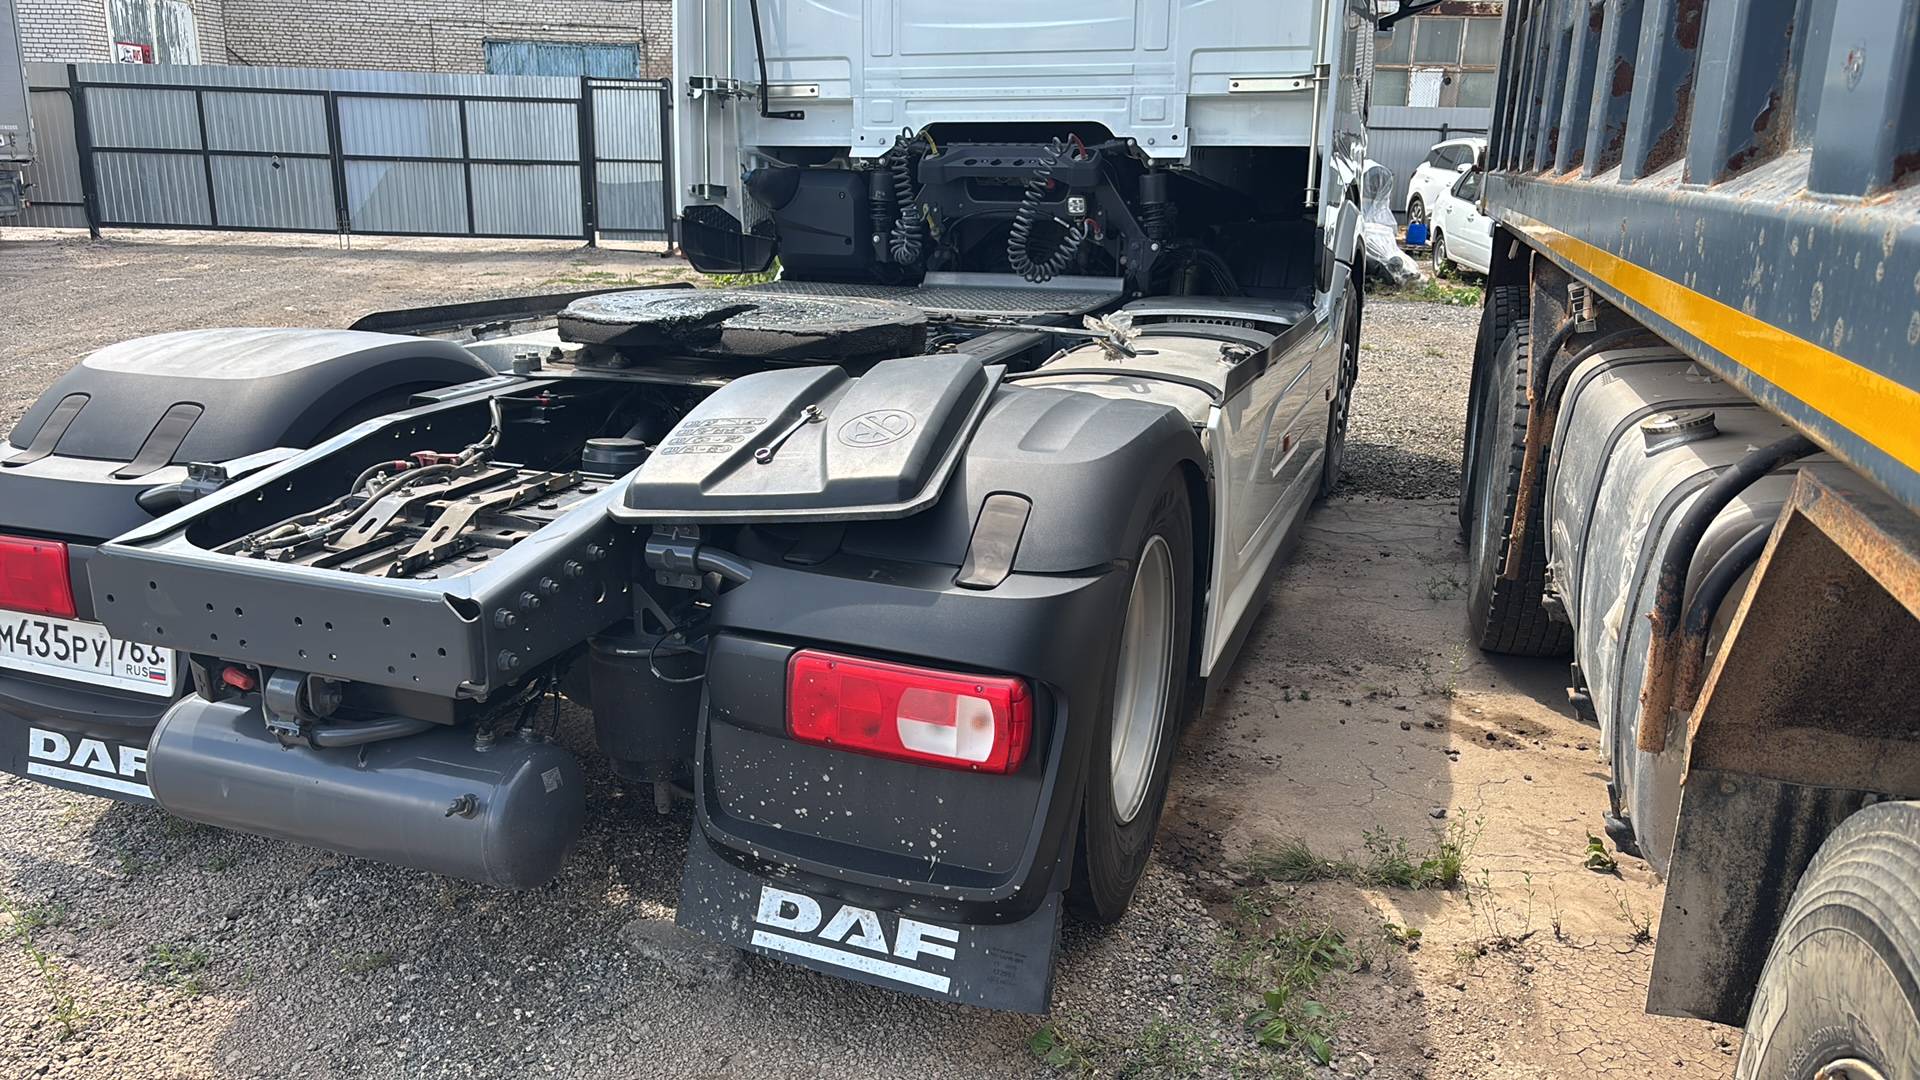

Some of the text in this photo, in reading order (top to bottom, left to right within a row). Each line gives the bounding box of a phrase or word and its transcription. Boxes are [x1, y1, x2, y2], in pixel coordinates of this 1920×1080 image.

[126, 664, 149, 677] RUS
[28, 727, 148, 777] DAF
[755, 886, 960, 961] DAF
